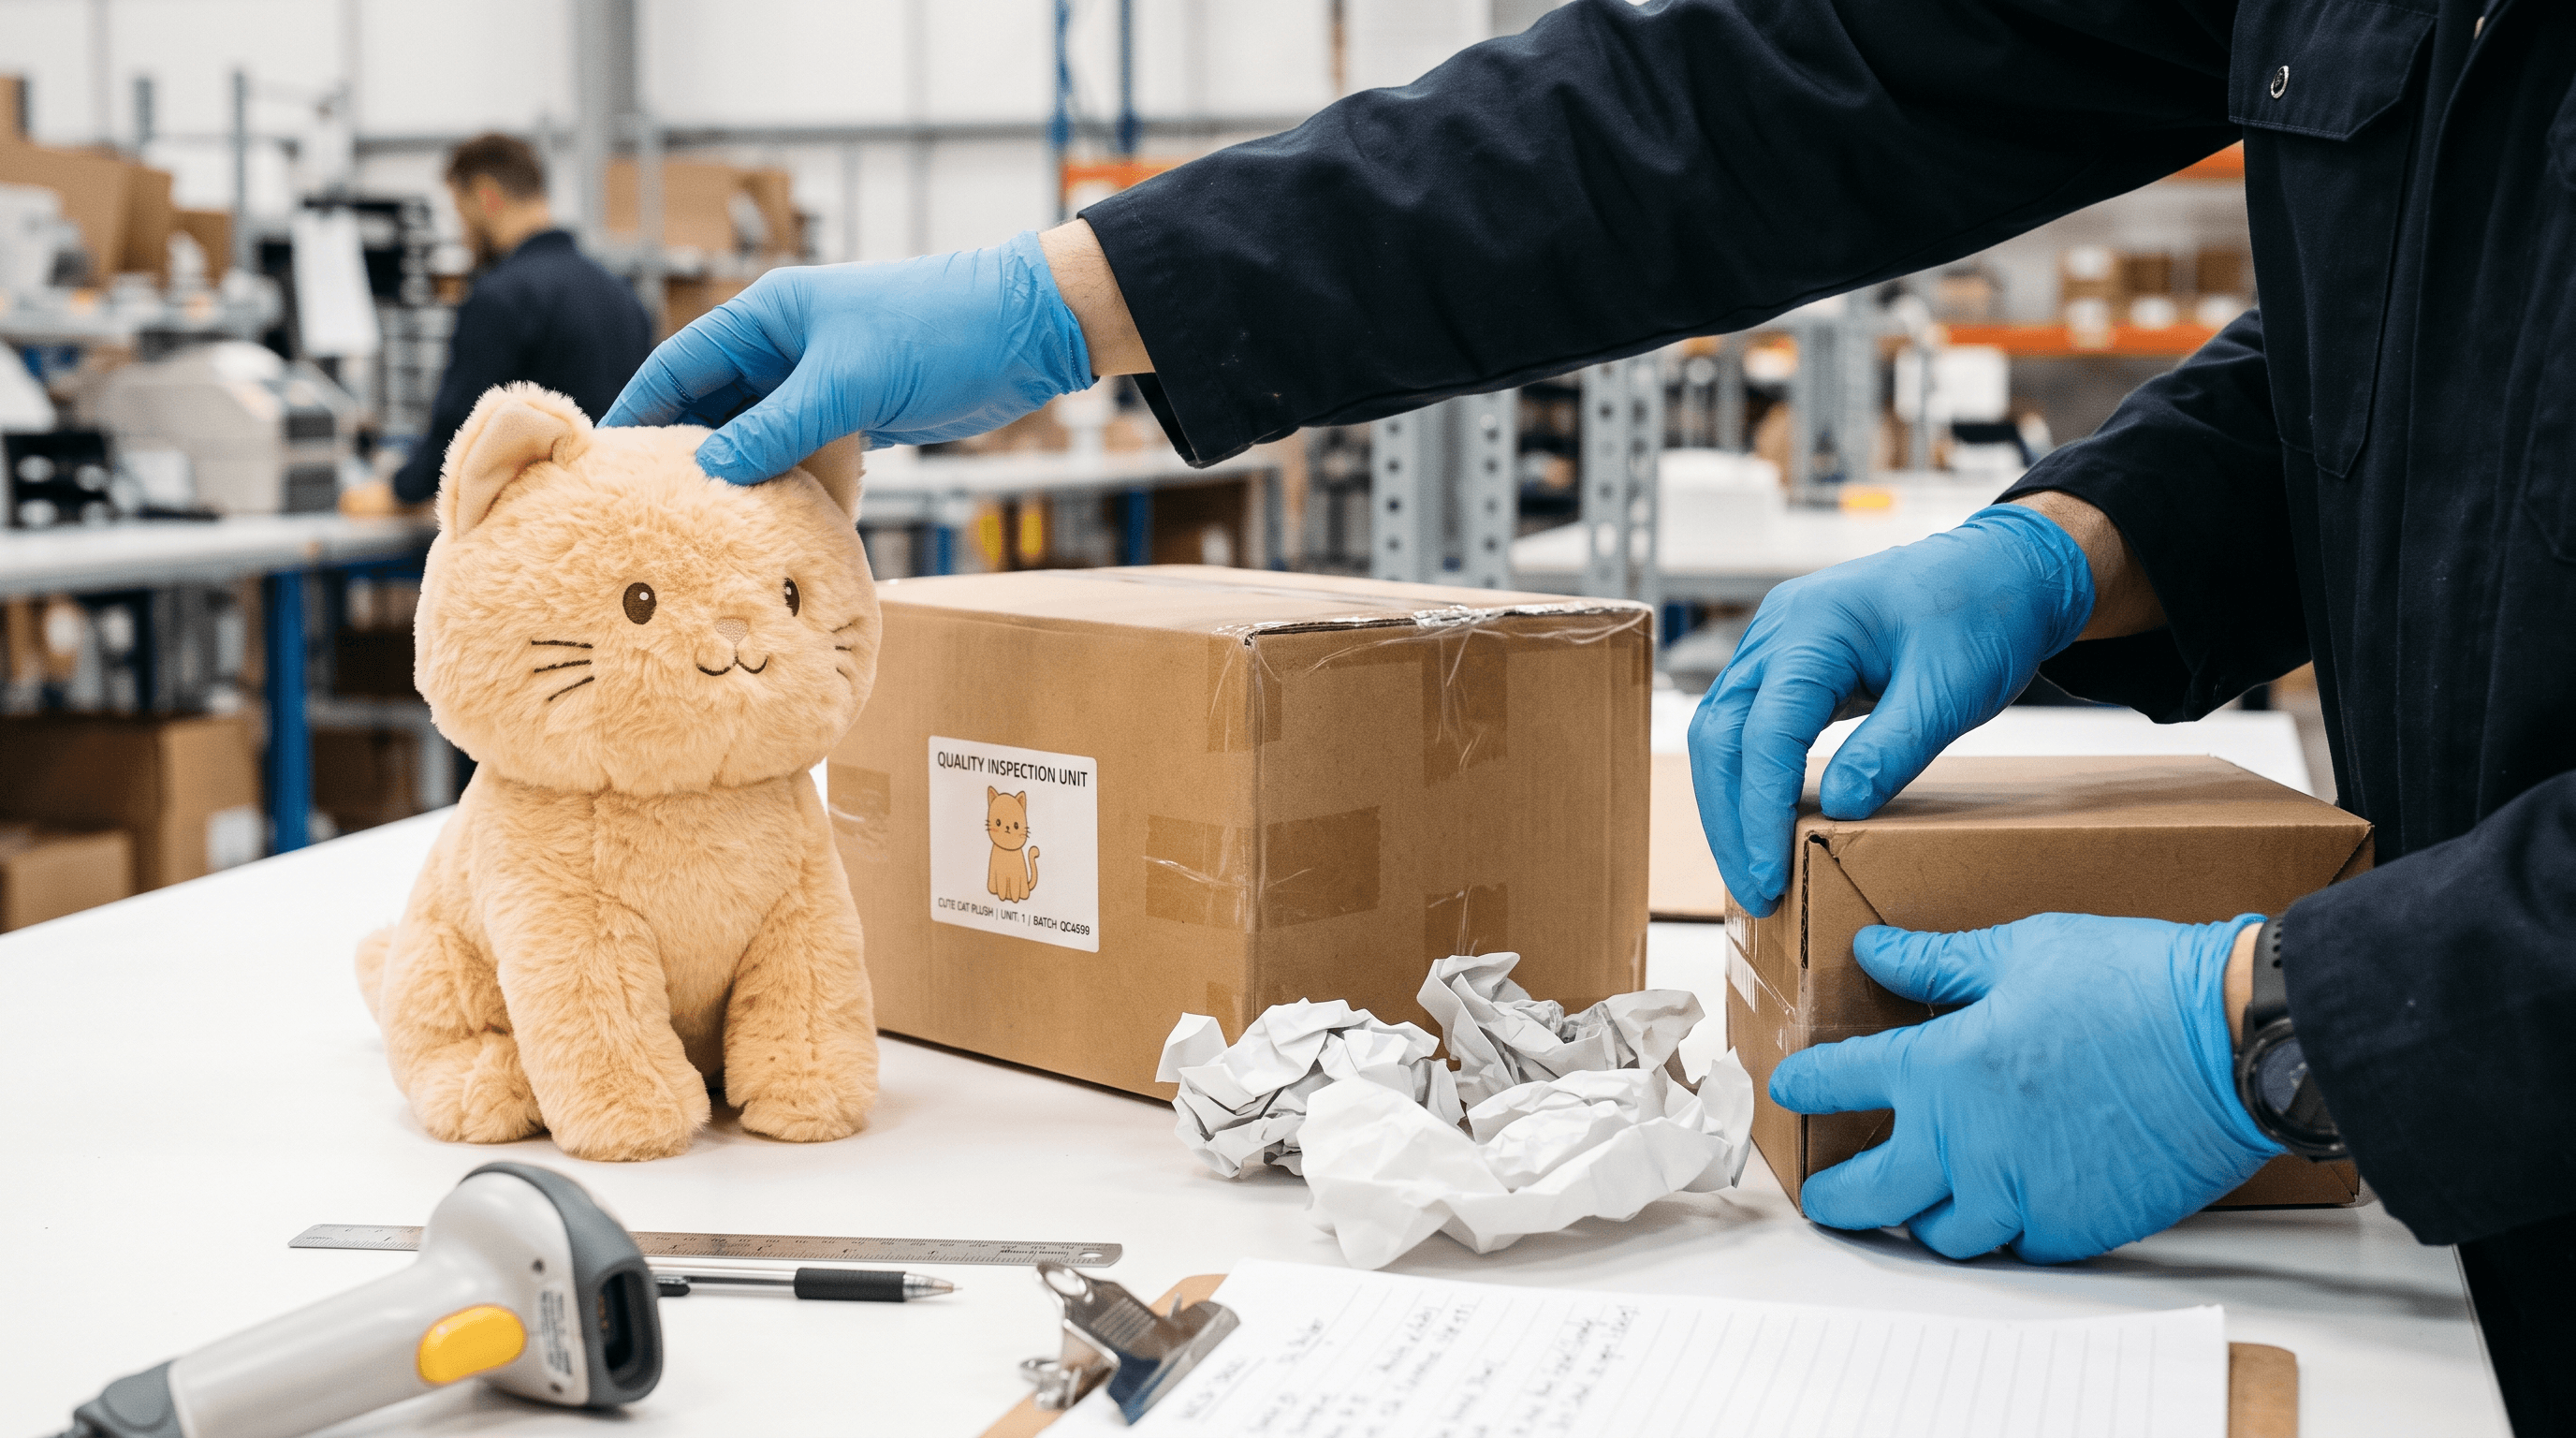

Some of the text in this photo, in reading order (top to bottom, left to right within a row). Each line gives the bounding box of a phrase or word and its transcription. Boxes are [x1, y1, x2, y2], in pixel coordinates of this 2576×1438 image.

[937, 751, 1088, 787] QUALITY INSPECTION UNIT
[938, 897, 956, 910] CUTE
[958, 901, 970, 913] CAT
[971, 903, 994, 917] PLUSH
[1021, 914, 1026, 923] 1
[1033, 916, 1058, 930] BATCH
[1060, 920, 1090, 935] QC4599
